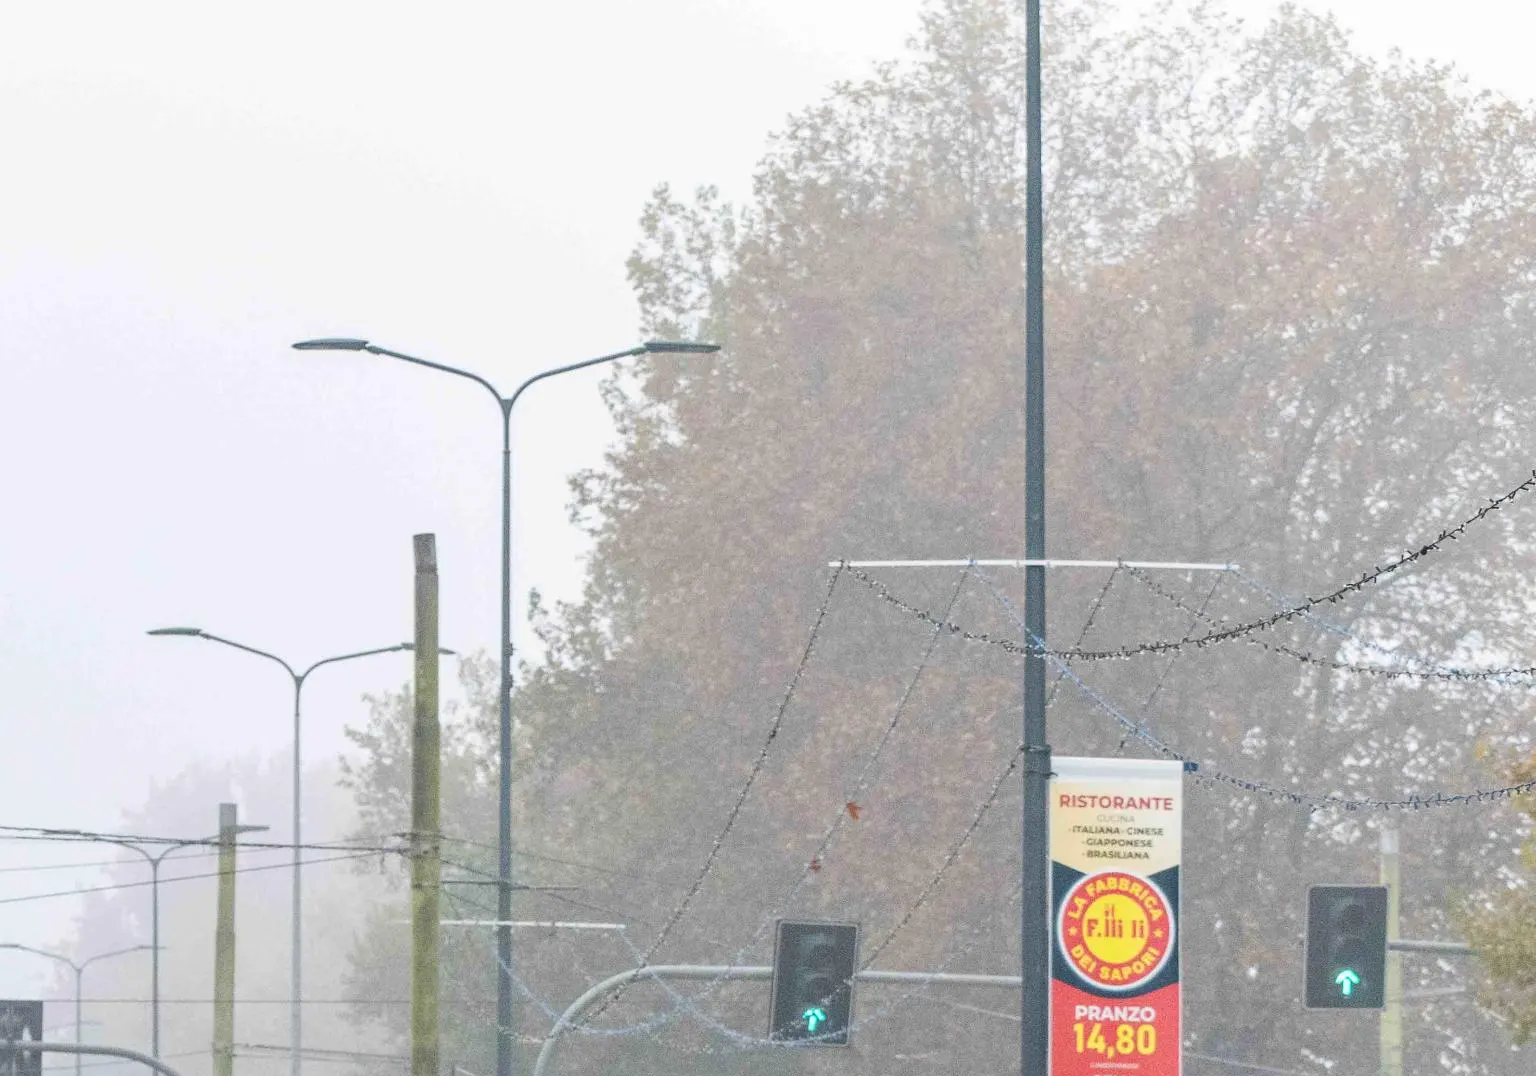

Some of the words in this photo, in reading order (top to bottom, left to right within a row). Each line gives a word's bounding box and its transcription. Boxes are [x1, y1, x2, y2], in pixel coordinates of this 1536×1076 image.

[1059, 794, 1174, 811] RISTORANTE
[1072, 825, 1120, 835] ITALIANA
[1126, 827, 1164, 836] CINESE
[1086, 838, 1153, 848] GIAPPONESE
[1086, 850, 1150, 860] BRASILIANA
[1068, 896, 1086, 920] LA
[1085, 877, 1163, 921] FABBRICA
[1071, 944, 1097, 973] DEI
[1099, 946, 1160, 981] SAPORI
[1075, 1005, 1156, 1022] PRANZO
[1073, 1023, 1157, 1058] 14,80
